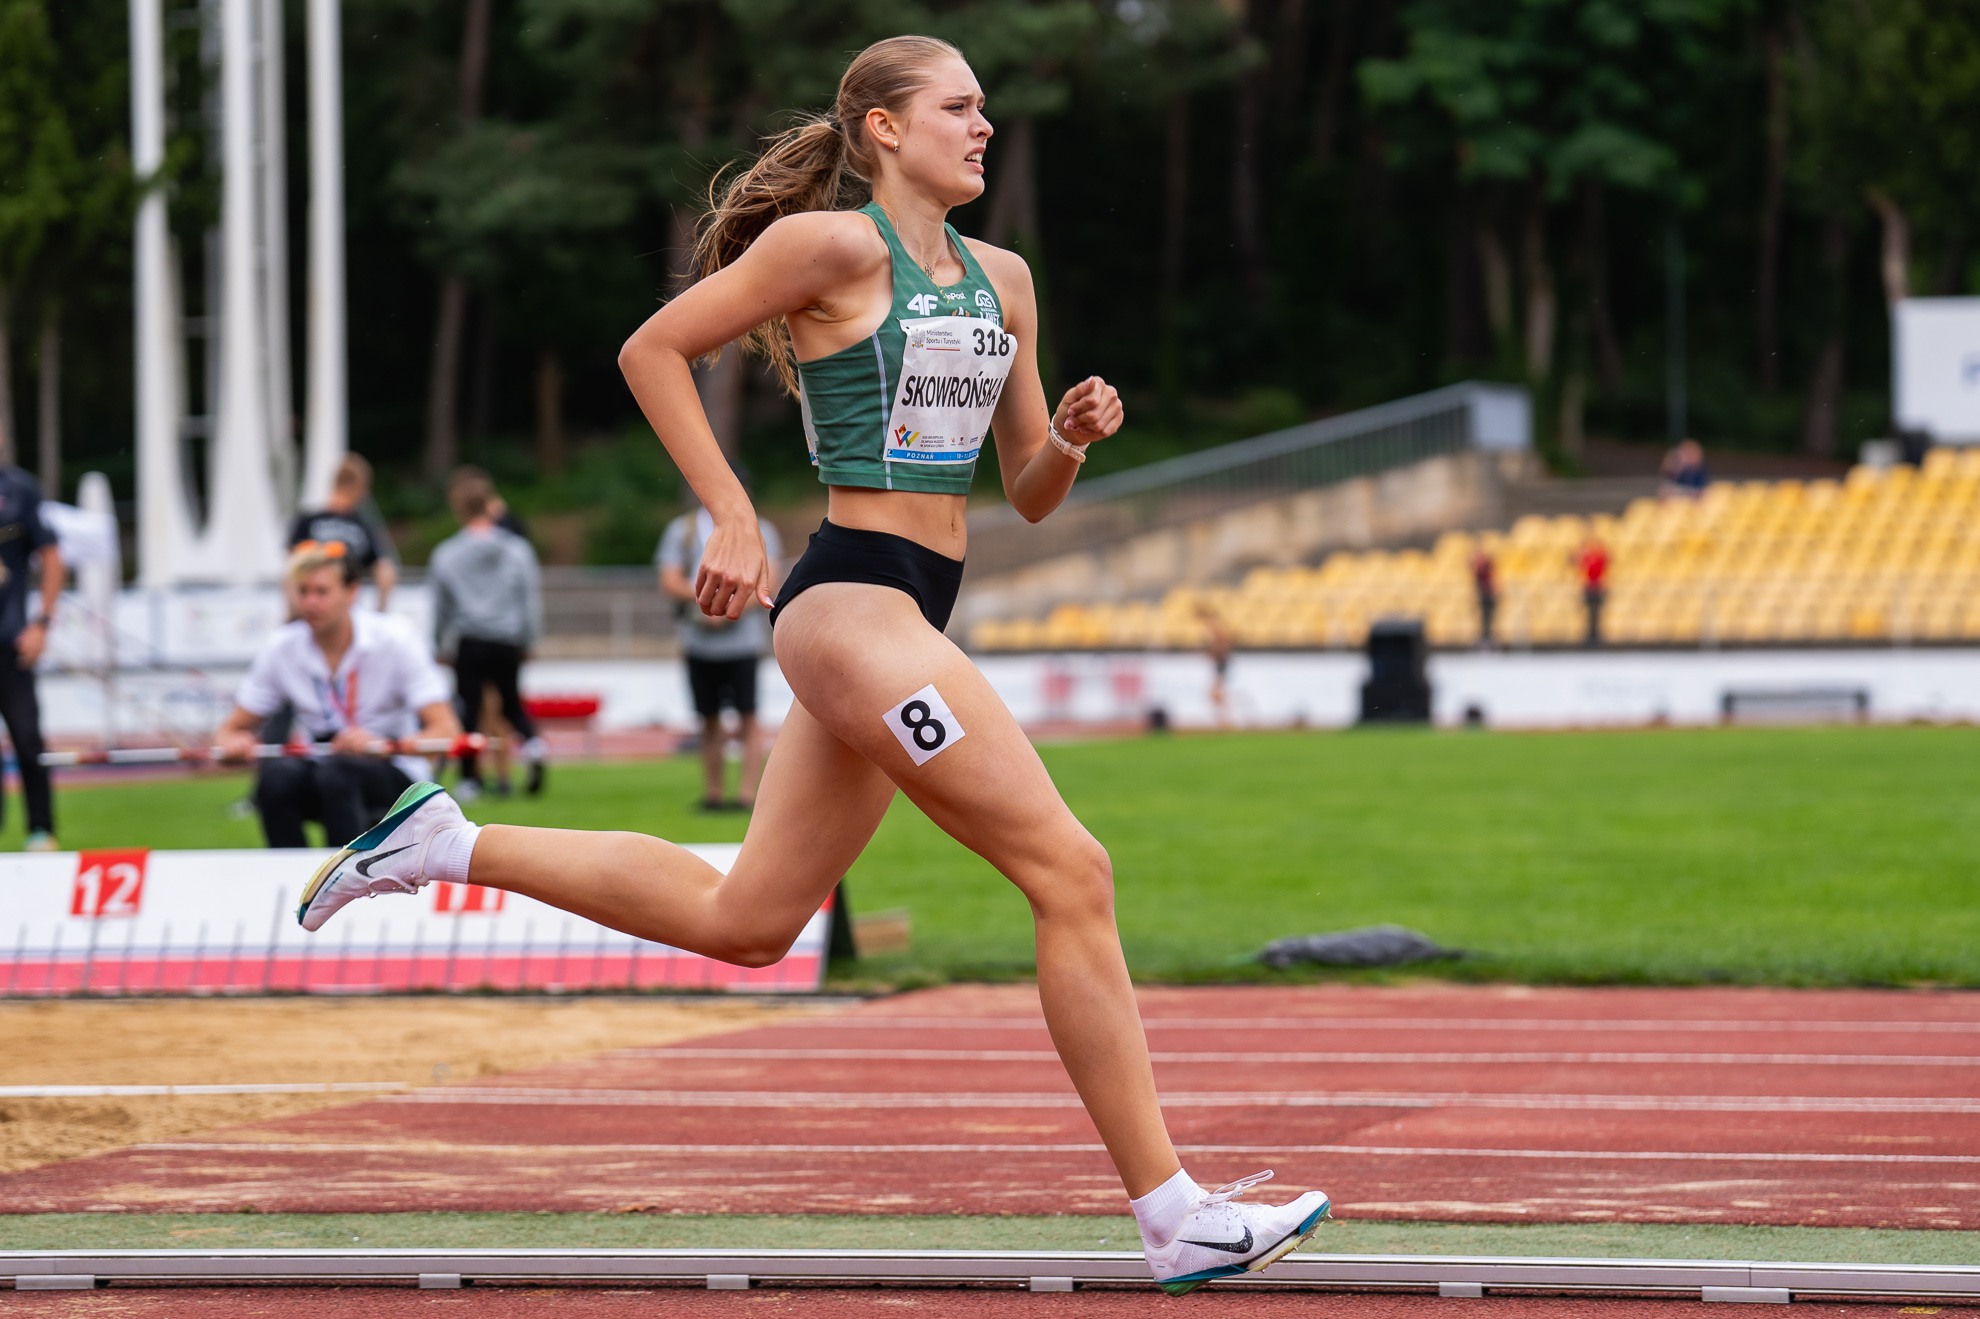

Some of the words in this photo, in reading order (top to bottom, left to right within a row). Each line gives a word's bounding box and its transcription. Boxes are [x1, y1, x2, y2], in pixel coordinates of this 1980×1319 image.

[907, 293, 938, 316] 4F
[973, 328, 1010, 357] 318
[901, 371, 1003, 409] SKOWROŃSKA
[906, 452, 934, 460] POZNAŃ
[901, 700, 946, 751] 8
[79, 863, 140, 918] 12
